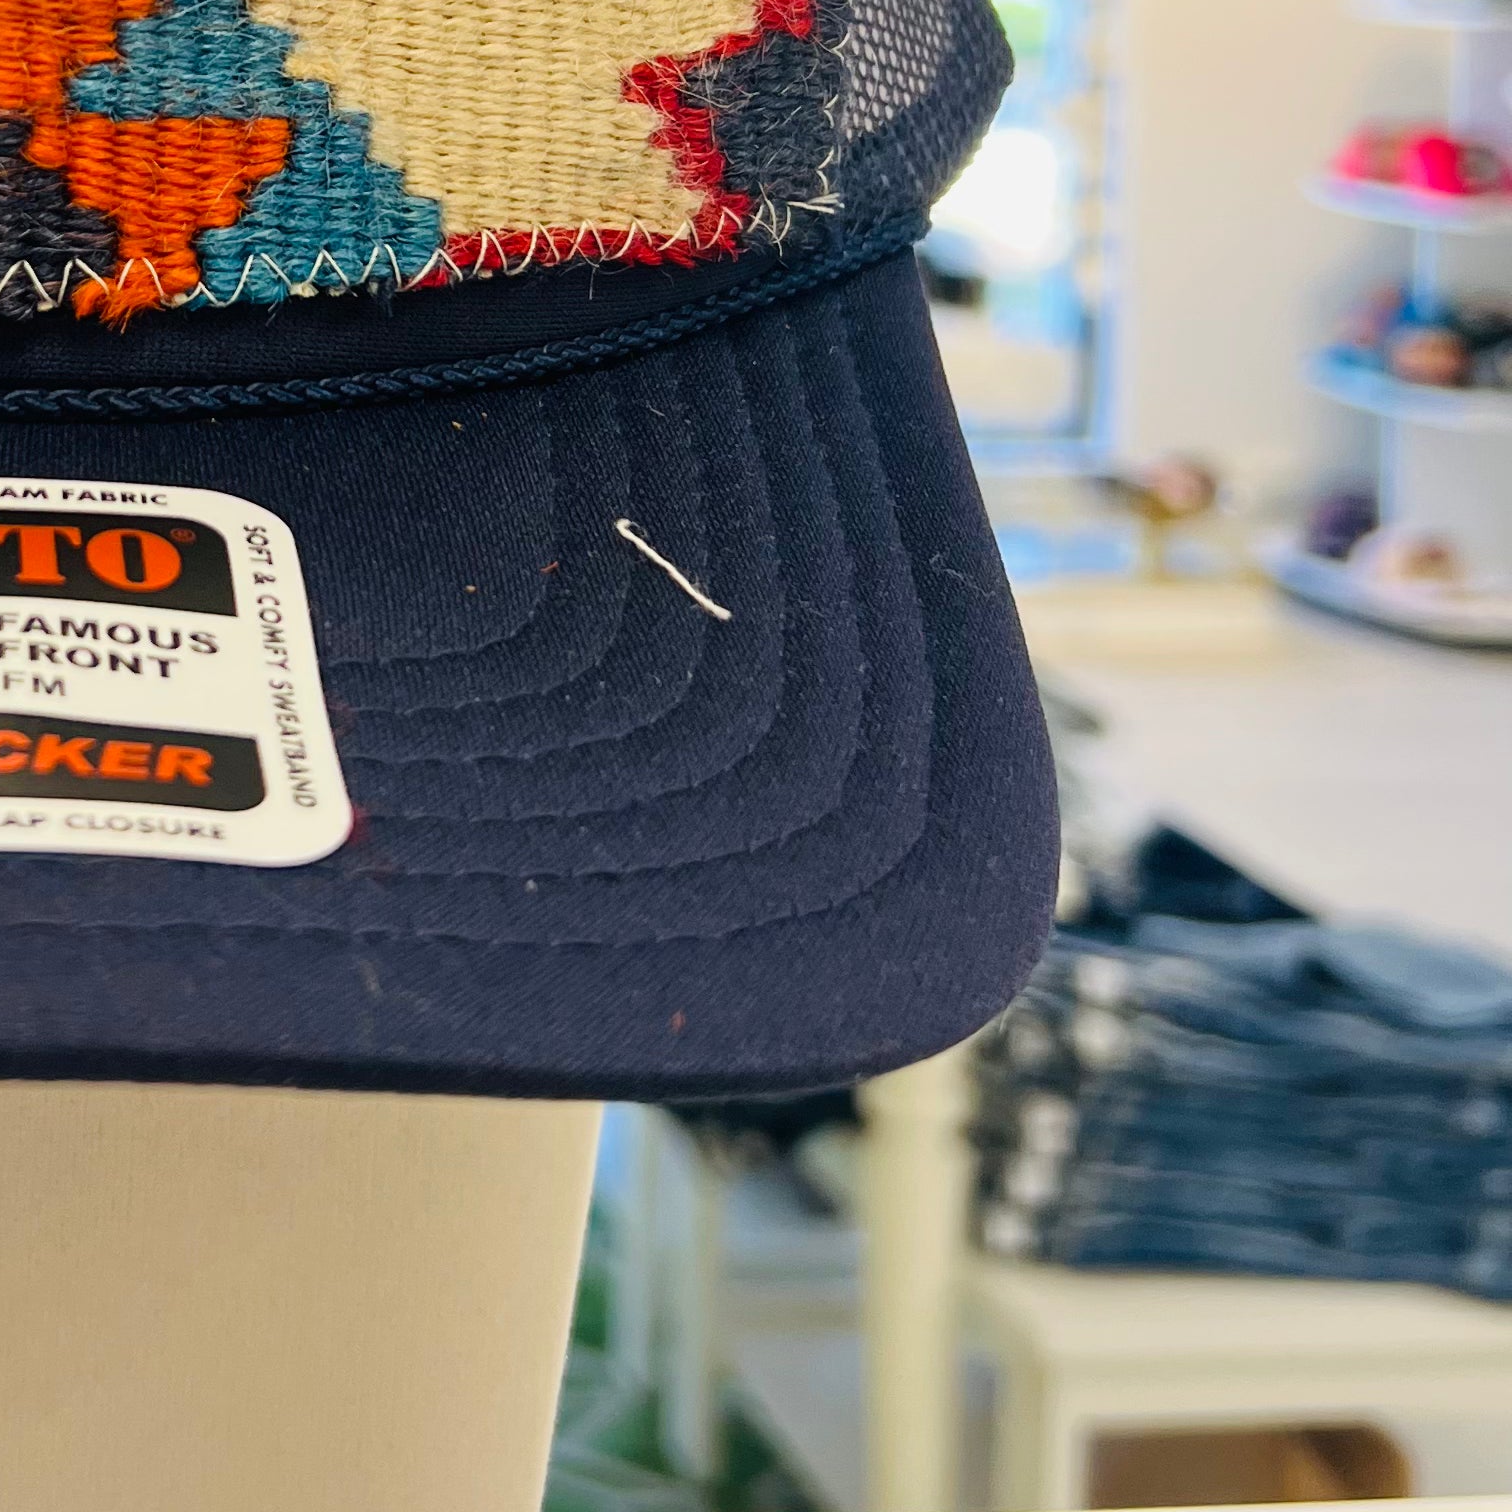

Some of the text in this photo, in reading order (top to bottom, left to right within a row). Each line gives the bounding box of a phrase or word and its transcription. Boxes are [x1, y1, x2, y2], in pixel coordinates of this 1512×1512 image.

[61, 488, 168, 506] FABRIC
[243, 523, 317, 808] SOFT & COMFY SWEATBAND
[63, 812, 226, 840] CLOSURE
